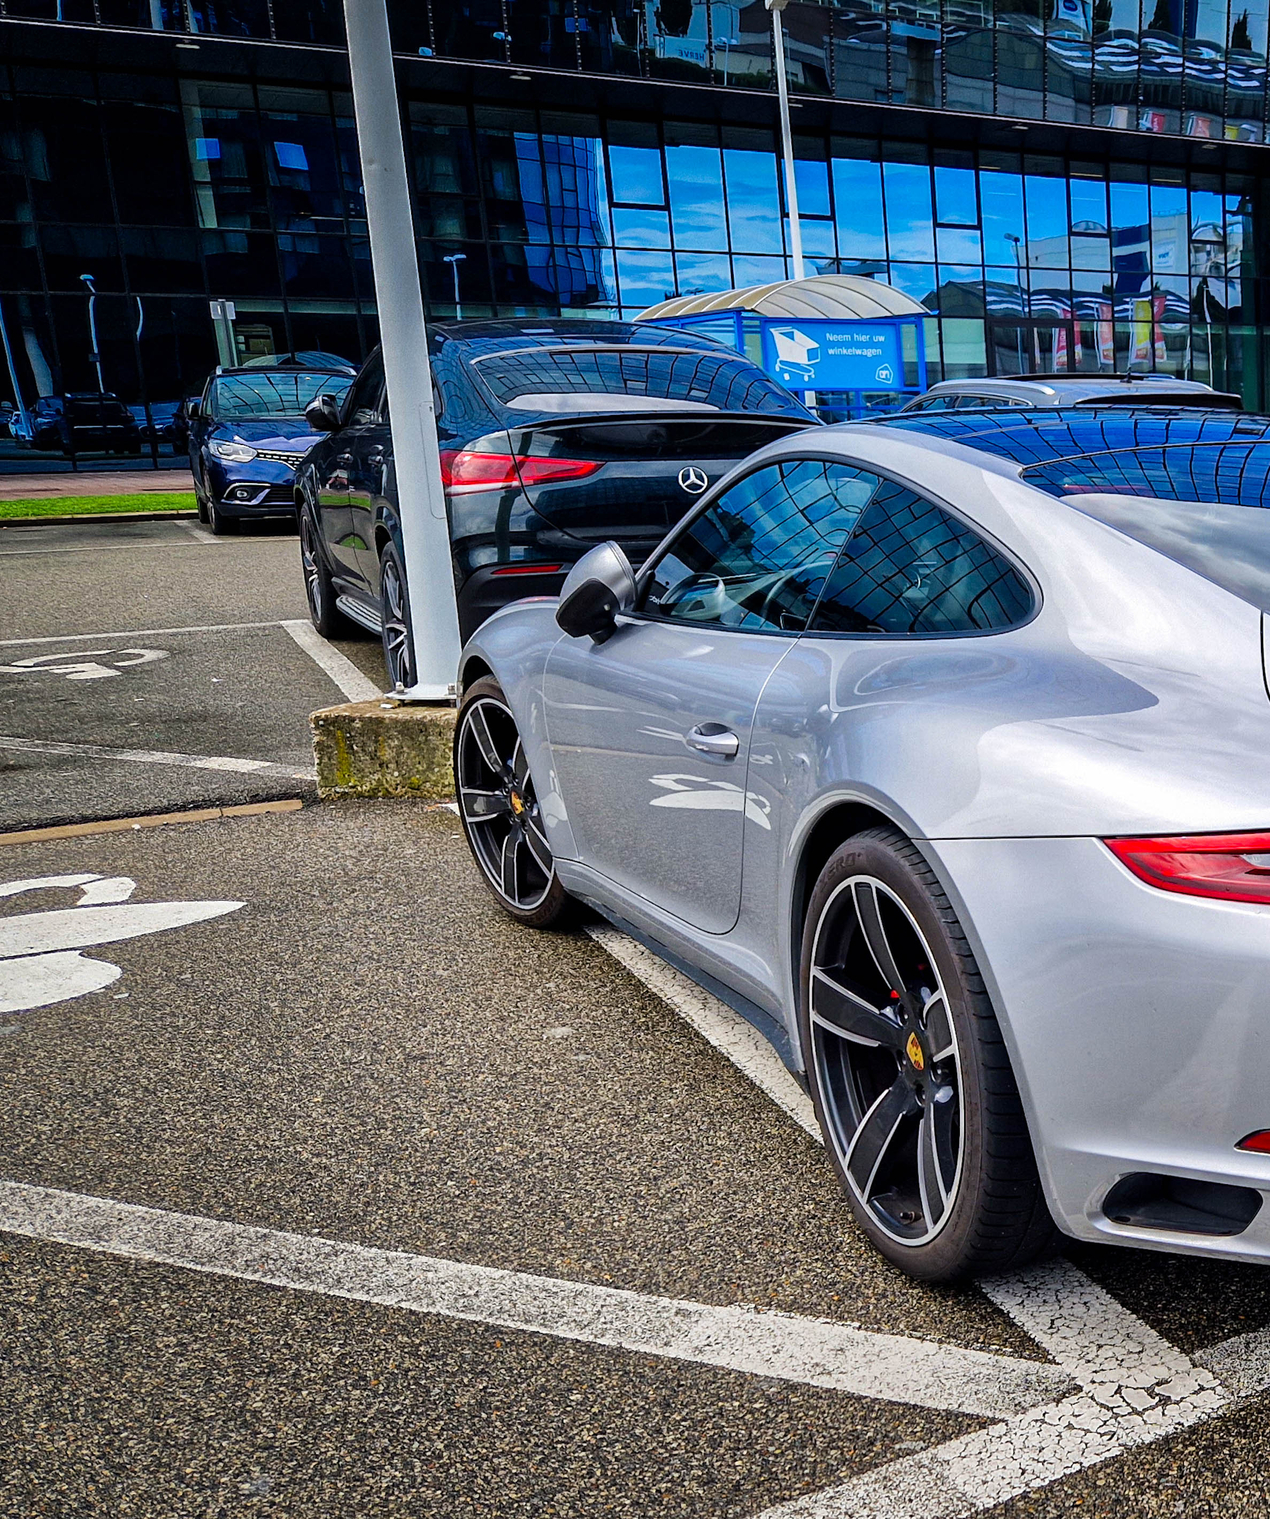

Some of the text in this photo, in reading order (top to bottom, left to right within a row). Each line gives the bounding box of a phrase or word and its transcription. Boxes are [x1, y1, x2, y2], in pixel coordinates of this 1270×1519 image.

[826, 333, 851, 342] Neem
[854, 333, 870, 342] hier
[828, 347, 882, 357] winkelwagen
